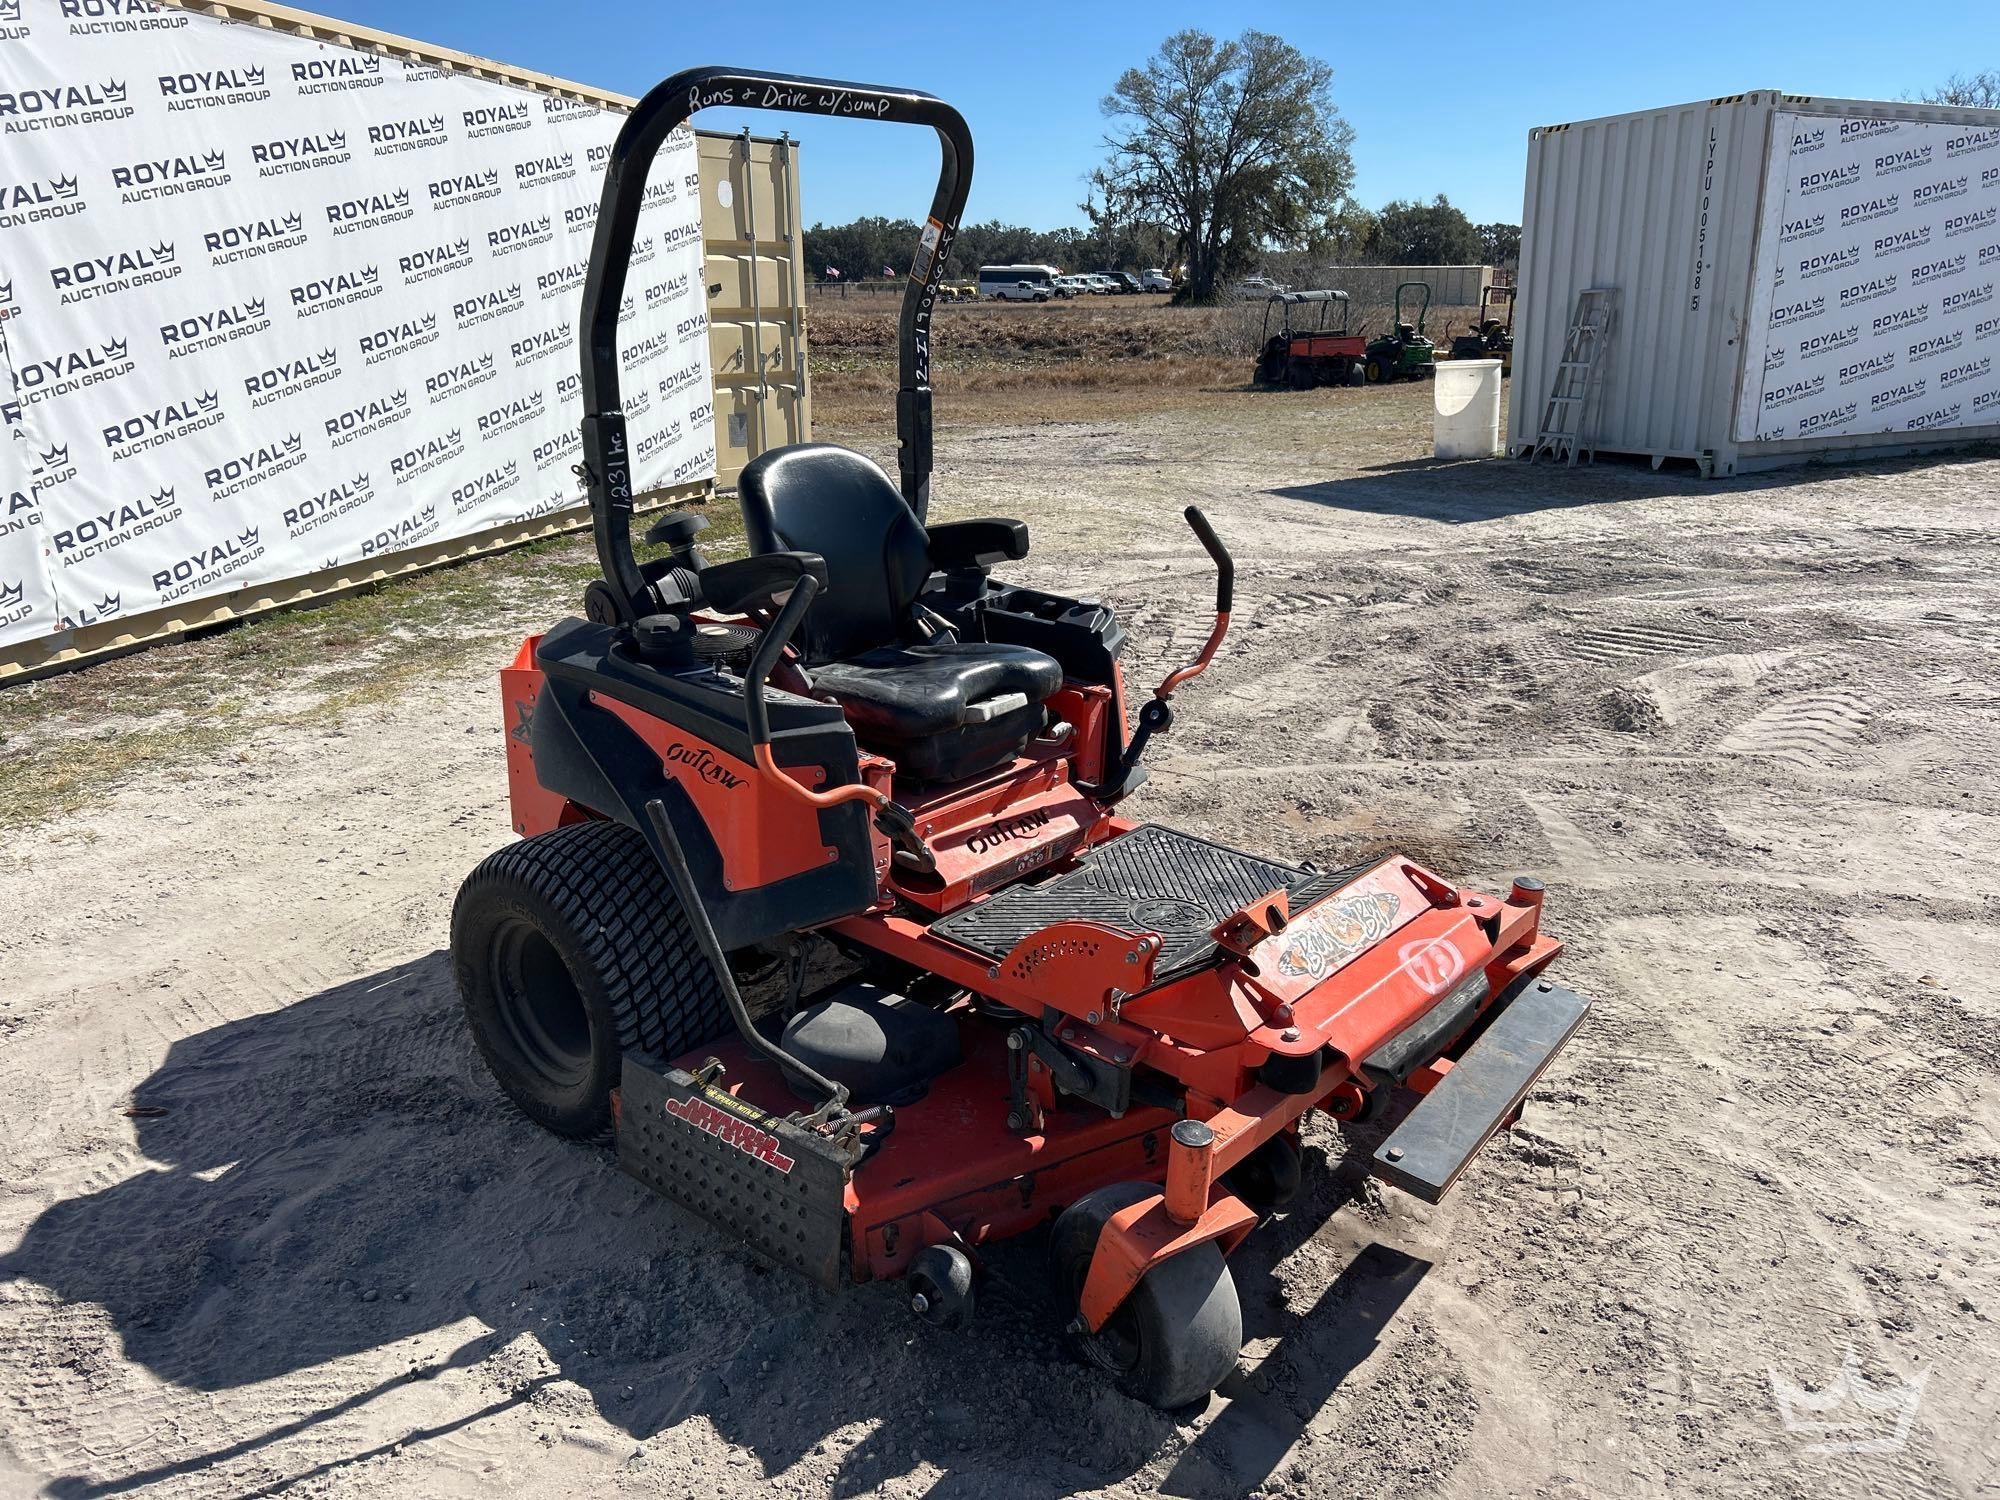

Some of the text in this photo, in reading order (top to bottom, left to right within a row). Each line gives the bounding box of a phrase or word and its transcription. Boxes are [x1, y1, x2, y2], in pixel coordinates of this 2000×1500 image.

[158, 70, 246, 96] ROYAL
[291, 58, 364, 81] ROYAL
[298, 77, 383, 95] AUCTION GROUP
[688, 86, 734, 113] Runs
[761, 84, 812, 108] Drive
[168, 90, 270, 112] AUCTION GROUP
[463, 105, 516, 126] ROYAL
[368, 119, 430, 143] ROYAL
[468, 121, 531, 138] AUCTION GROUP
[252, 136, 329, 163] ROYAL
[374, 135, 448, 156] AUCTION GROUP
[1876, 149, 1920, 169] ROYAL
[112, 156, 206, 188] ROYAL
[260, 153, 351, 177] AUCTION GROUP
[515, 156, 562, 178] ROYAL
[1801, 168, 1847, 188] ROYAL
[1876, 158, 1932, 177] AUCTION GROUP
[122, 174, 231, 204] AUCTION GROUP
[428, 174, 485, 199] ROYAL
[520, 170, 576, 189] AUCTION GROUP
[1801, 176, 1860, 196] AUCTION GROUP
[1914, 180, 1956, 199] ROYAL
[326, 194, 395, 222] ROYAL
[434, 188, 501, 211] AUCTION GROUP
[1841, 199, 1886, 219] ROYAL
[1914, 188, 1967, 207] AUCTION GROUP
[333, 209, 413, 236] AUCTION GROUP
[1841, 207, 1898, 227] AUCTION GROUP
[1945, 211, 1986, 230] ROYAL
[1945, 219, 1996, 238] AUCTION GROUP
[204, 219, 284, 252] ROYAL
[488, 221, 539, 246] ROYAL
[492, 233, 553, 257] AUCTION GROUP
[1875, 230, 1918, 250] ROYAL
[213, 235, 307, 266] AUCTION GROUP
[399, 245, 456, 273] ROYAL
[1800, 251, 1847, 271] ROYAL
[1875, 238, 1930, 258] AUCTION GROUP
[50, 250, 153, 289] ROYAL
[405, 257, 473, 285] AUCTION GROUP
[1801, 258, 1859, 280] AUCTION GROUP
[1912, 259, 1954, 279] ROYAL
[1912, 266, 1965, 286] AUCTION GROUP
[61, 266, 181, 305] AUCTION GROUP
[290, 272, 362, 305] ROYAL
[1840, 287, 1896, 308] AUCTION GROUP
[1841, 280, 1884, 300] ROYAL
[298, 286, 382, 319] AUCTION GROUP
[453, 290, 508, 319] ROYAL
[459, 301, 524, 330] AUCTION GROUP
[160, 306, 247, 345] ROYAL
[1873, 309, 1916, 329] ROYAL
[1874, 316, 1928, 336] AUCTION GROUP
[169, 320, 270, 360] AUCTION GROUP
[360, 321, 423, 354] ROYAL
[366, 332, 439, 366] AUCTION GROUP
[511, 329, 559, 357] ROYAL
[622, 338, 658, 362] ROYAL
[1801, 331, 1846, 352] ROYAL
[1801, 338, 1858, 360] AUCTION GROUP
[516, 338, 573, 368] AUCTION GROUP
[625, 345, 668, 372] AUCTION GROUP
[244, 357, 320, 395] ROYAL
[426, 361, 480, 393] ROYAL
[1840, 357, 1883, 378] ROYAL
[1840, 364, 1894, 386] AUCTION GROUP
[253, 368, 341, 409] AUCTION GROUP
[431, 370, 496, 404] AUCTION GROUP
[1765, 381, 1811, 403] ROYAL
[1765, 387, 1824, 410] AUCTION GROUP
[103, 401, 198, 447] ROYAL
[325, 399, 393, 436] ROYAL
[478, 398, 531, 431] ROYAL
[484, 407, 545, 440] AUCTION GROUP
[113, 412, 224, 462] AUCTION GROUP
[332, 408, 411, 449] AUCTION GROUP
[204, 444, 284, 488] ROYAL
[391, 438, 448, 474] ROYAL
[397, 445, 464, 486] AUCTION GROUP
[213, 453, 306, 502] AUCTION GROUP
[452, 469, 504, 505] ROYAL
[283, 484, 354, 527] ROYAL
[458, 476, 519, 516] AUCTION GROUP
[53, 500, 154, 553] ROYAL
[291, 491, 374, 540] AUCTION GROUP
[64, 508, 182, 568] AUCTION GROUP
[152, 540, 241, 591] ROYAL
[162, 546, 264, 604] AUCTION GROUP
[686, 1097, 780, 1150] ADVANCED
